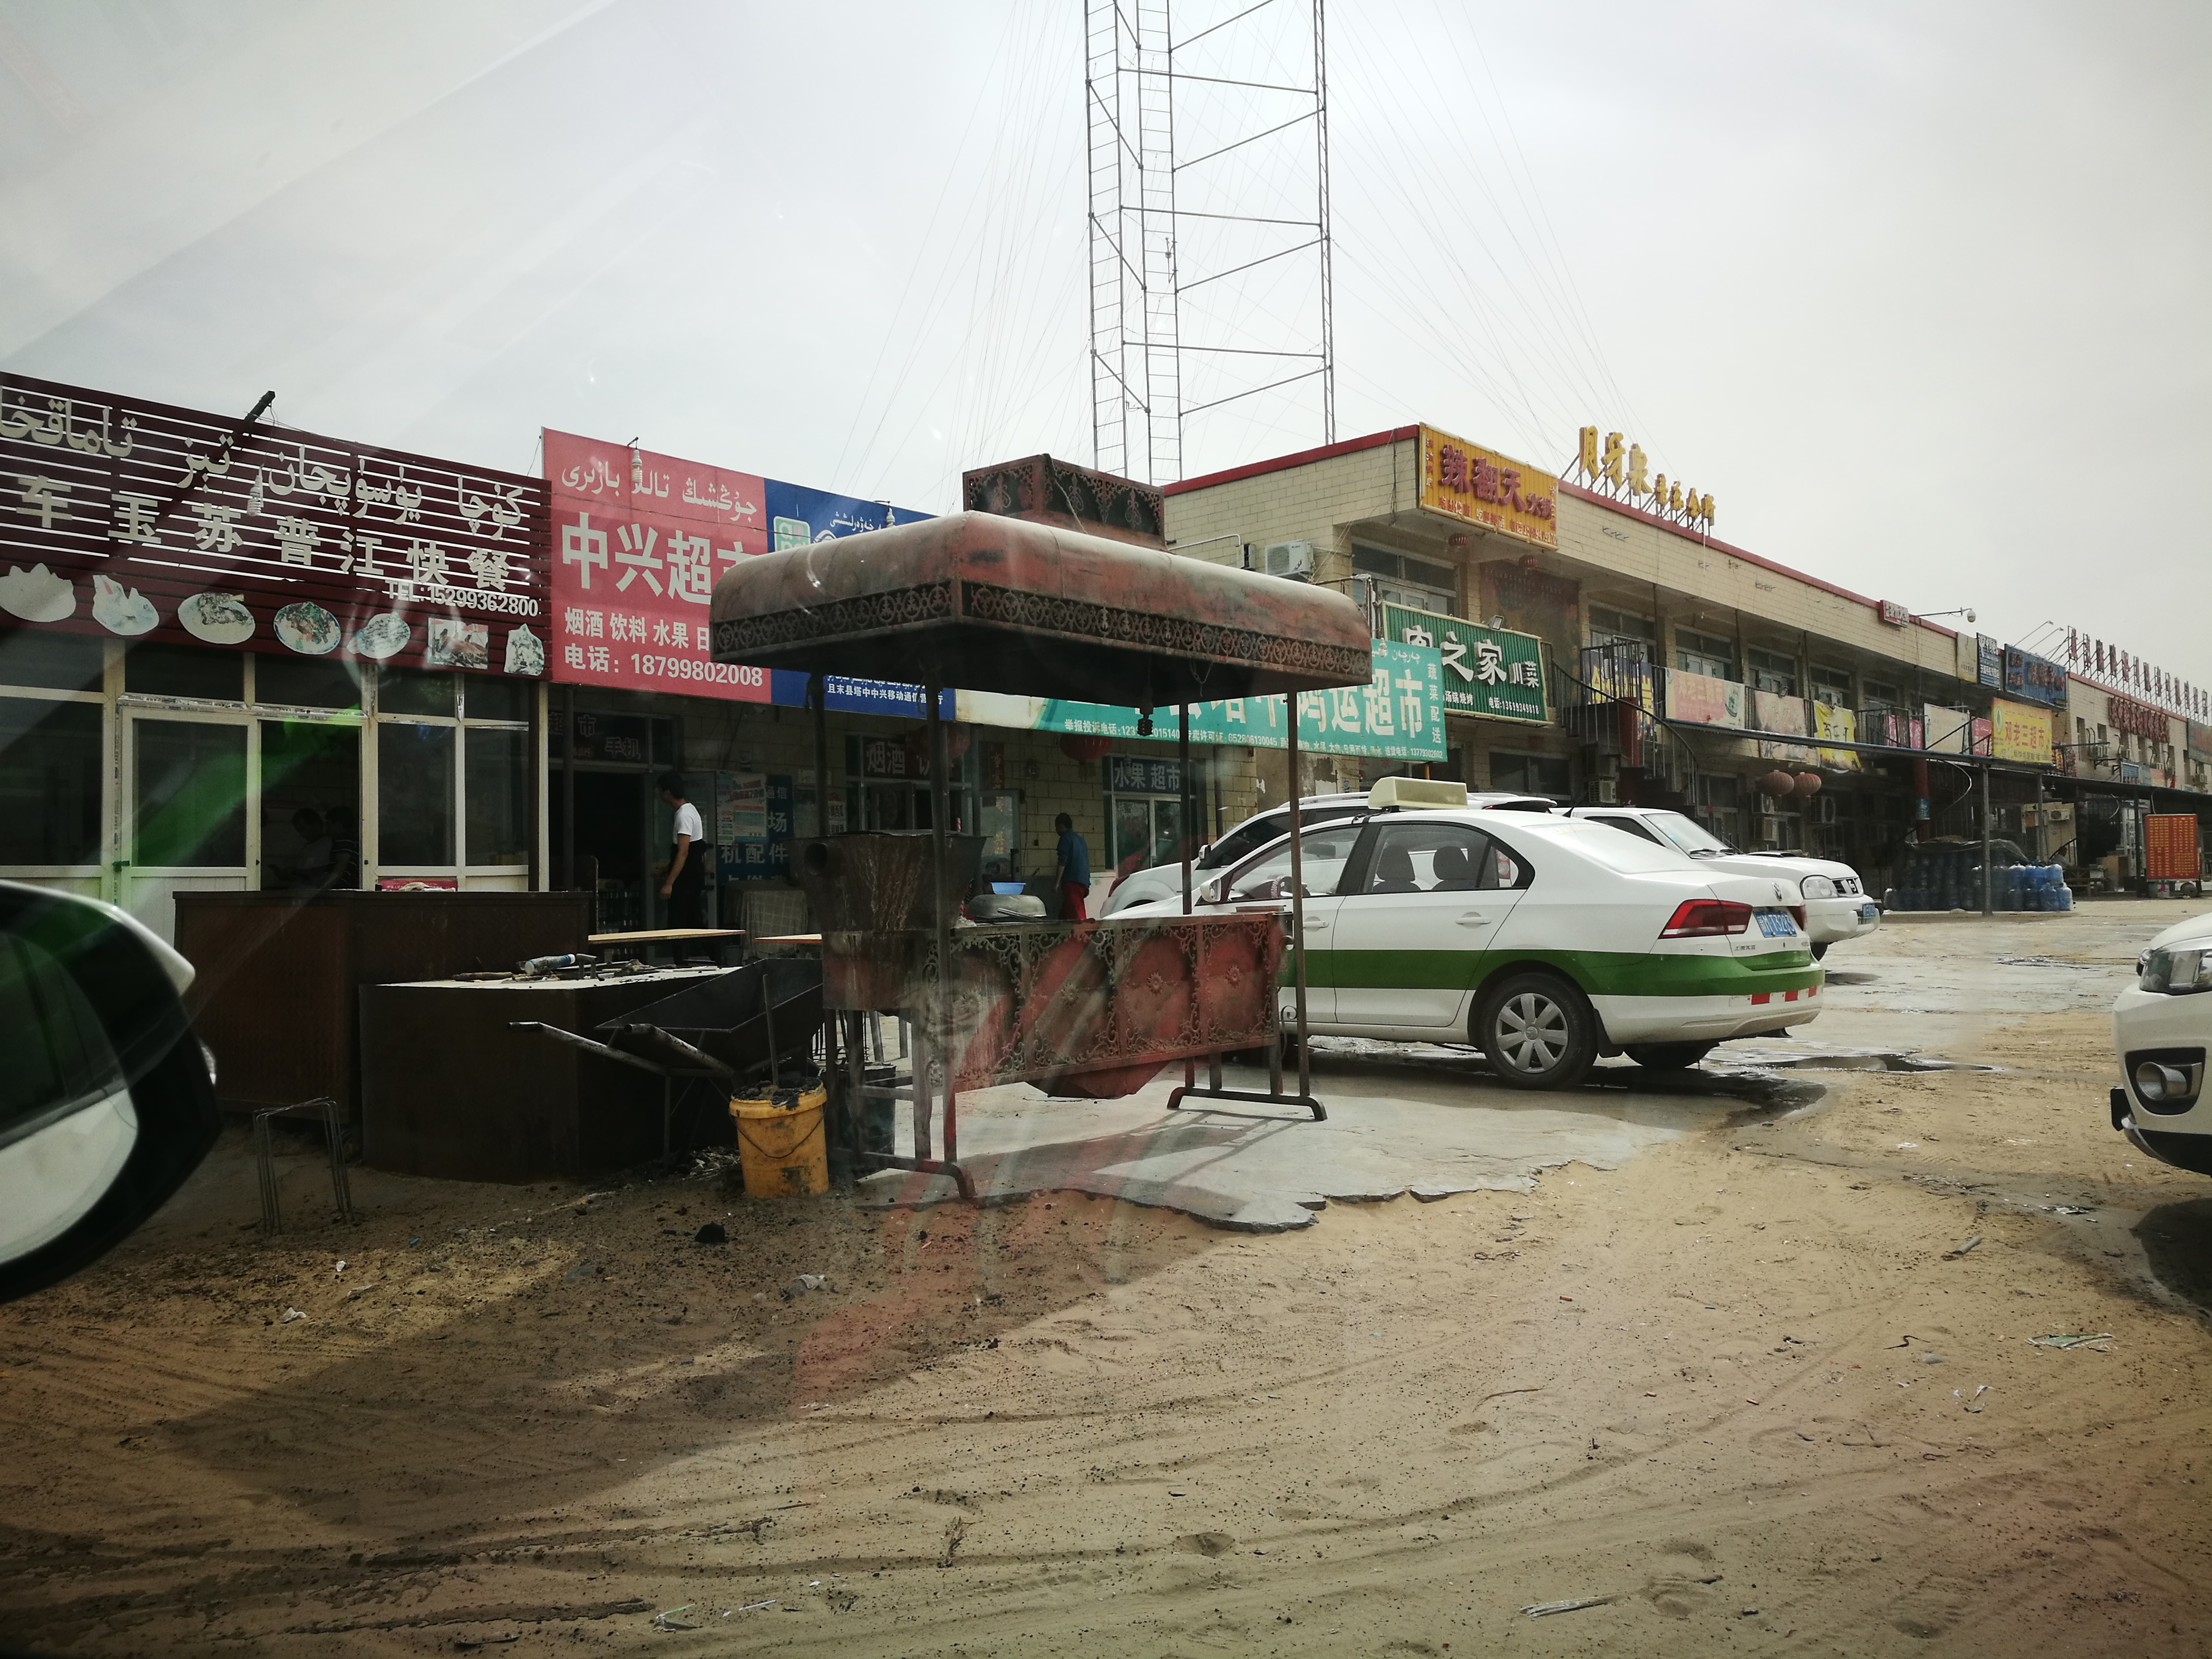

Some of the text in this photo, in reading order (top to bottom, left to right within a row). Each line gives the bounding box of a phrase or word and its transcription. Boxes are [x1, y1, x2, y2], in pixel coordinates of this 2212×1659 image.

[1438, 444, 1527, 512] 辣翻天
[16, 474, 510, 591] 车玉苏普江快餐
[565, 607, 603, 638] 烟酒
[610, 613, 647, 644] 饮料
[653, 619, 689, 651] 水果
[631, 653, 763, 687] 18799802008
[1508, 661, 1539, 688] 川菜
[827, 683, 944, 705] 且末县塔中中兴移动通信营
[1427, 663, 1442, 744] 蔬菜配送
[1443, 690, 1473, 705] 汤锅烧烤
[1064, 719, 1141, 736] 举报投诉电话:123
[866, 741, 905, 775] 烟酒
[1114, 760, 1180, 791] 水果 超市
